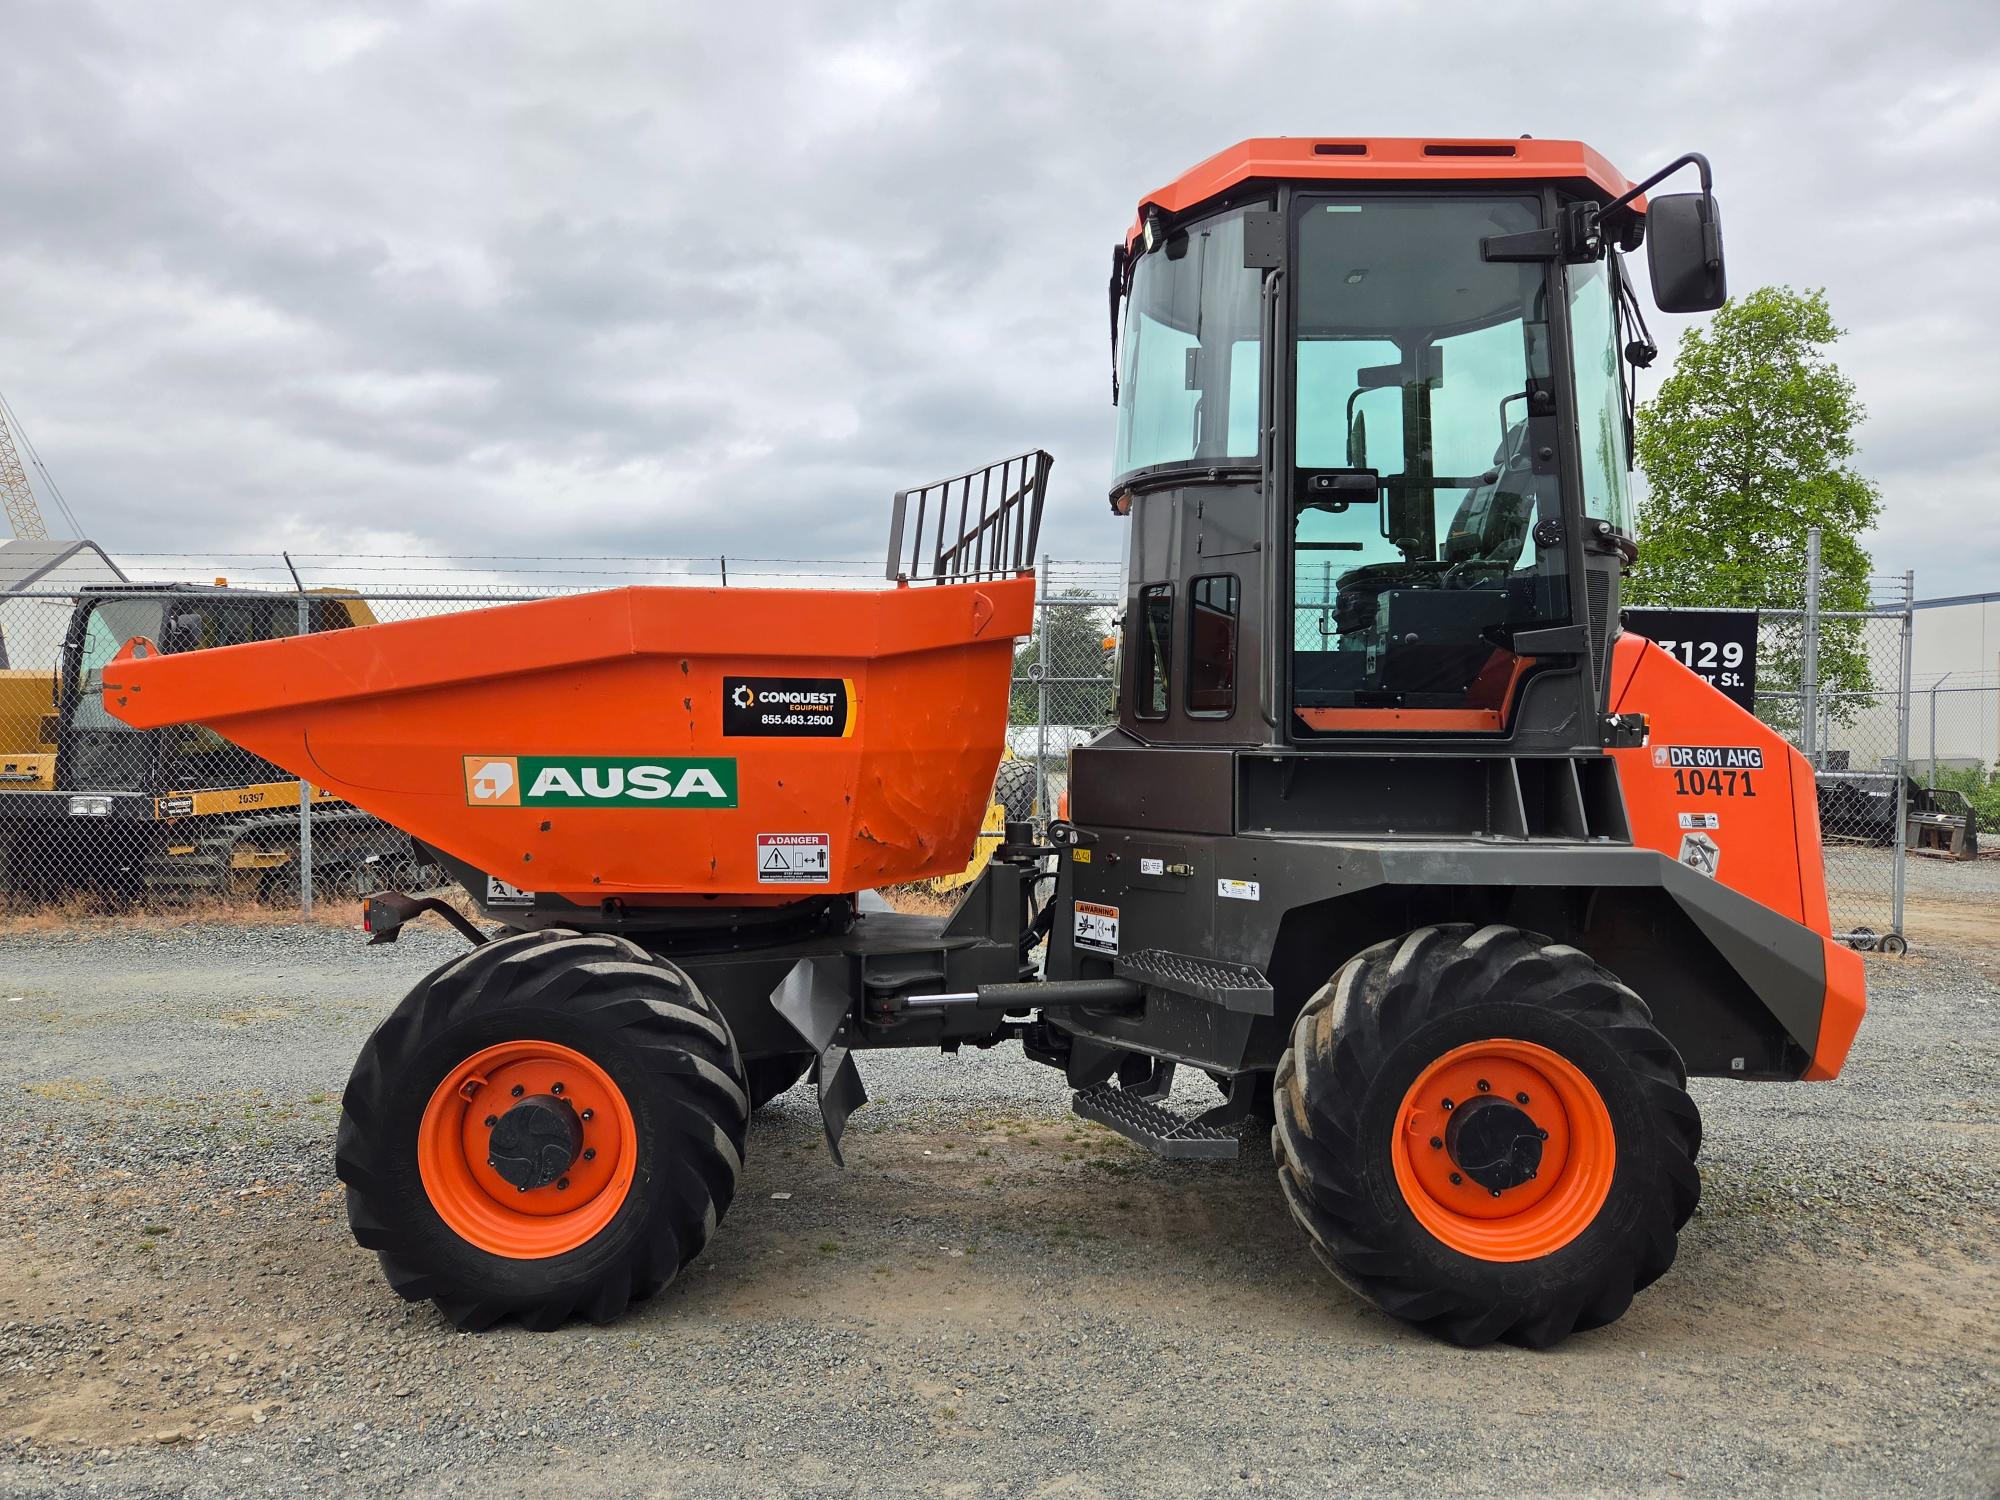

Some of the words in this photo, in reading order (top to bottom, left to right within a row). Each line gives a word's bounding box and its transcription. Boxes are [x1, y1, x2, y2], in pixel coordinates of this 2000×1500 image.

[1720, 672, 1744, 687] St.
[758, 691, 837, 704] CONQUEST
[789, 704, 834, 712] EQUIPMENT
[761, 714, 834, 726] 855.483.2500
[1670, 747, 1695, 766] DR
[1696, 748, 1723, 767] 601
[1726, 749, 1761, 767] AHG
[527, 765, 728, 800] AUSA
[1673, 769, 1757, 797] 10471
[776, 836, 819, 845] DANGER
[1083, 904, 1114, 917] WARNING
